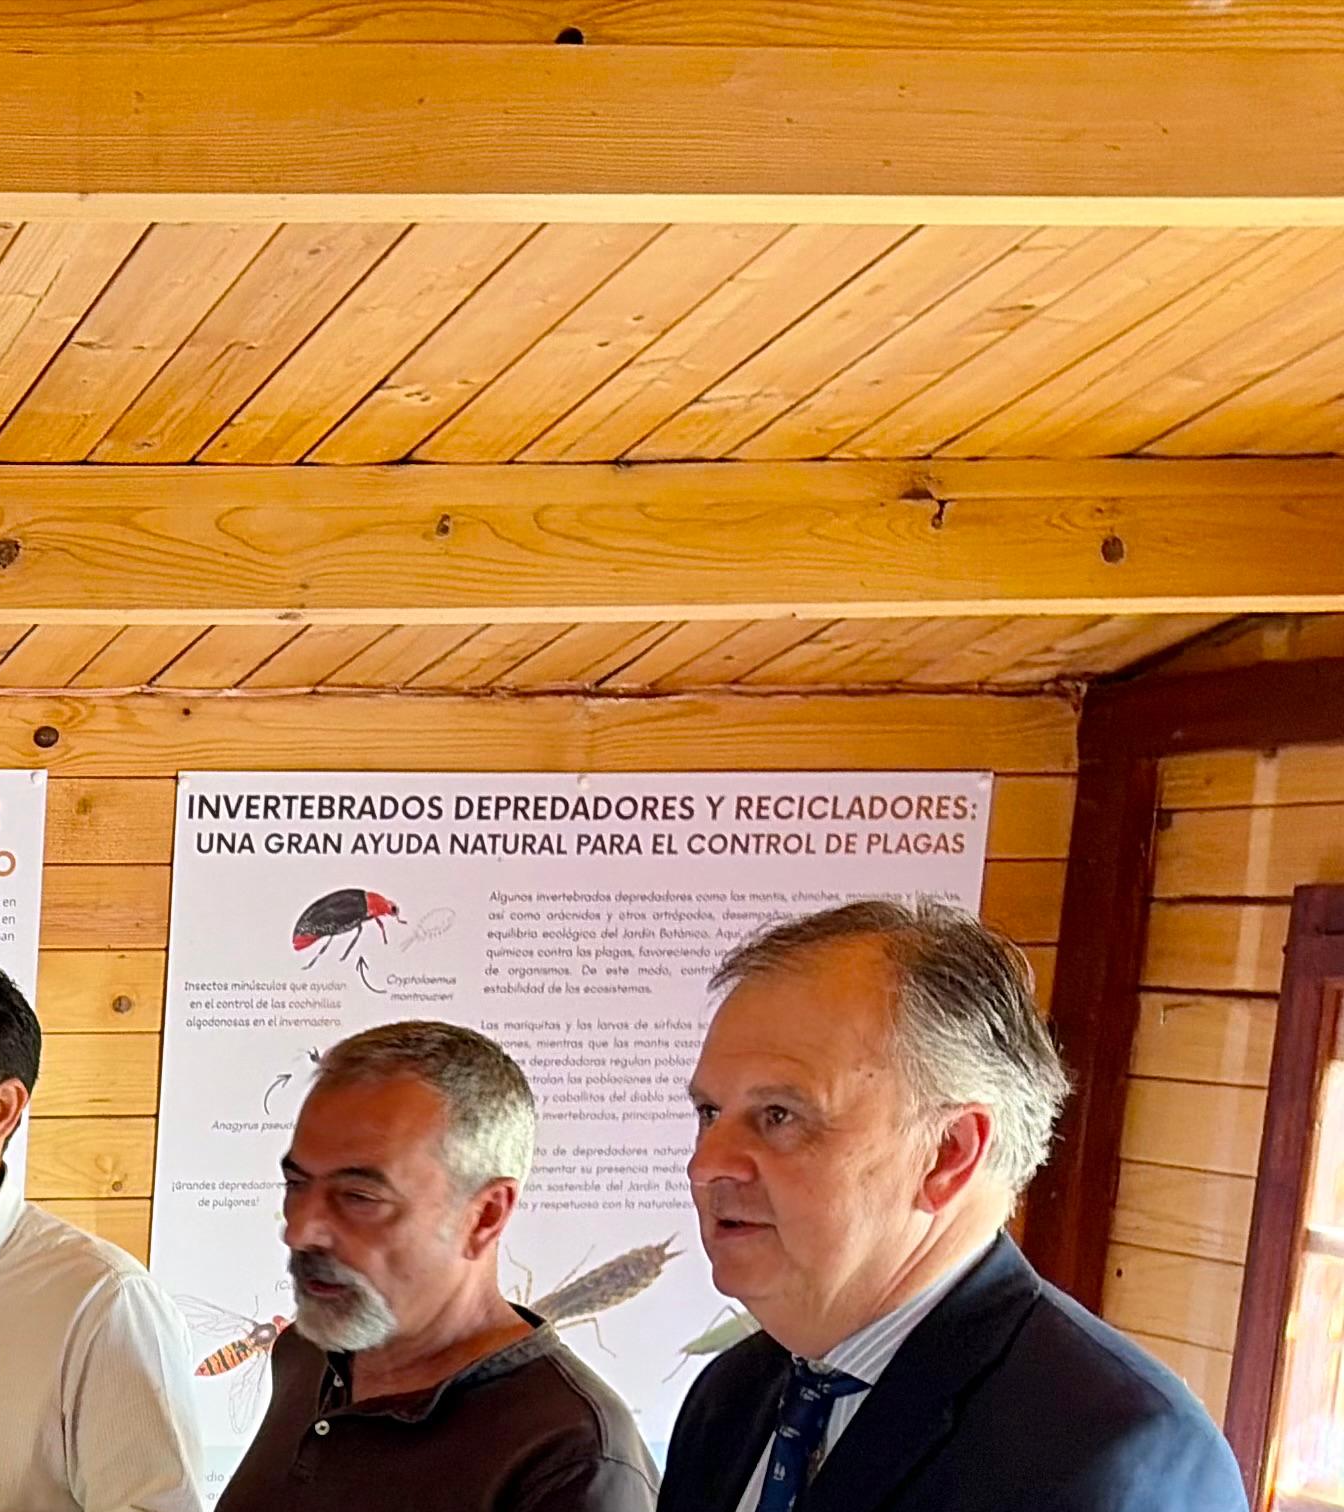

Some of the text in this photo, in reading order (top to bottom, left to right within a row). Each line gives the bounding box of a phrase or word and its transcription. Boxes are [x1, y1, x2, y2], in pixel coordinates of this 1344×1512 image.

[188, 794, 976, 820] INVERTEBRADOS DEPREDADORES Y RECICLADORES:
[196, 831, 964, 855] UNA GRAN AYUDA NATURAL PARA EL CONTROL DE PLAGAS
[2, 897, 16, 907] en
